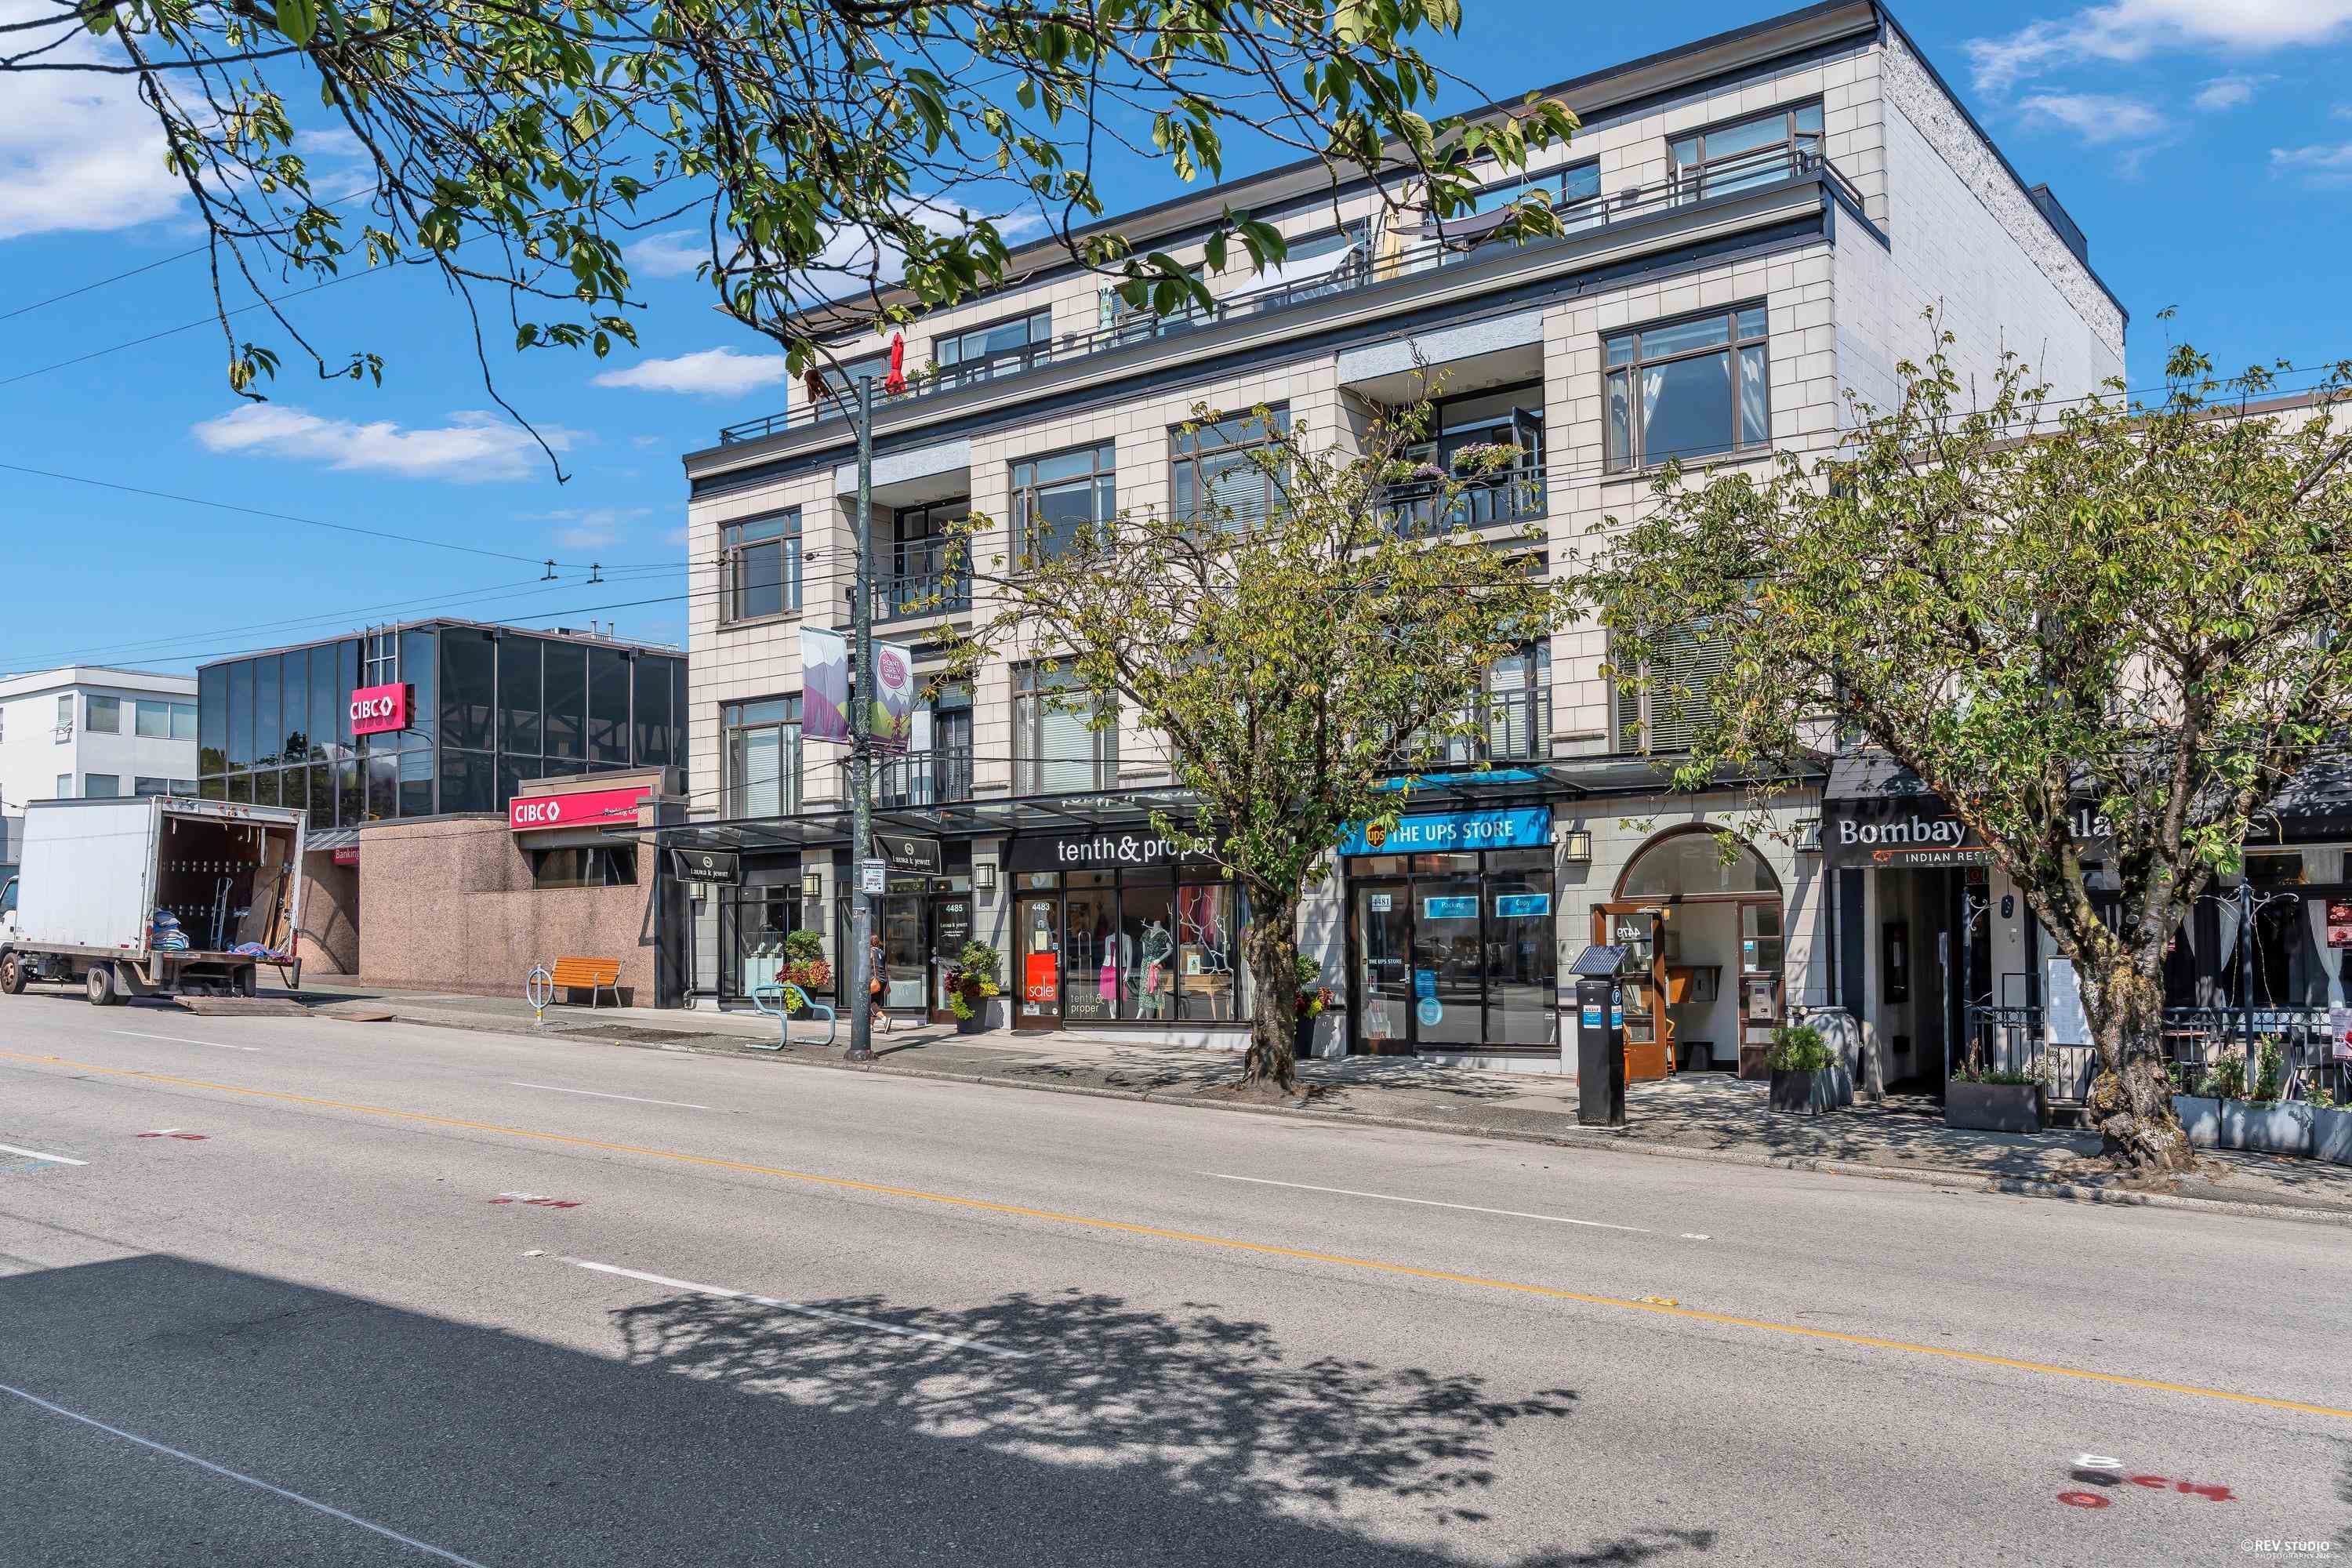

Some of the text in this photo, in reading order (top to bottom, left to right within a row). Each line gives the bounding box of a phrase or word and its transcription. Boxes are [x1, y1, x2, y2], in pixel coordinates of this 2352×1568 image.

[350, 699, 379, 720] CIBC
[514, 803, 546, 822] CIBC
[1367, 829, 1385, 845] ups
[1392, 820, 1514, 843] THE UPS STORE
[1838, 815, 1967, 848] Bombay
[1906, 852, 1951, 862] INDIAN
[946, 904, 963, 913] 4485
[1032, 902, 1050, 911] 4483
[1029, 975, 1054, 997] sale
[1071, 1004, 1099, 1014] proper
